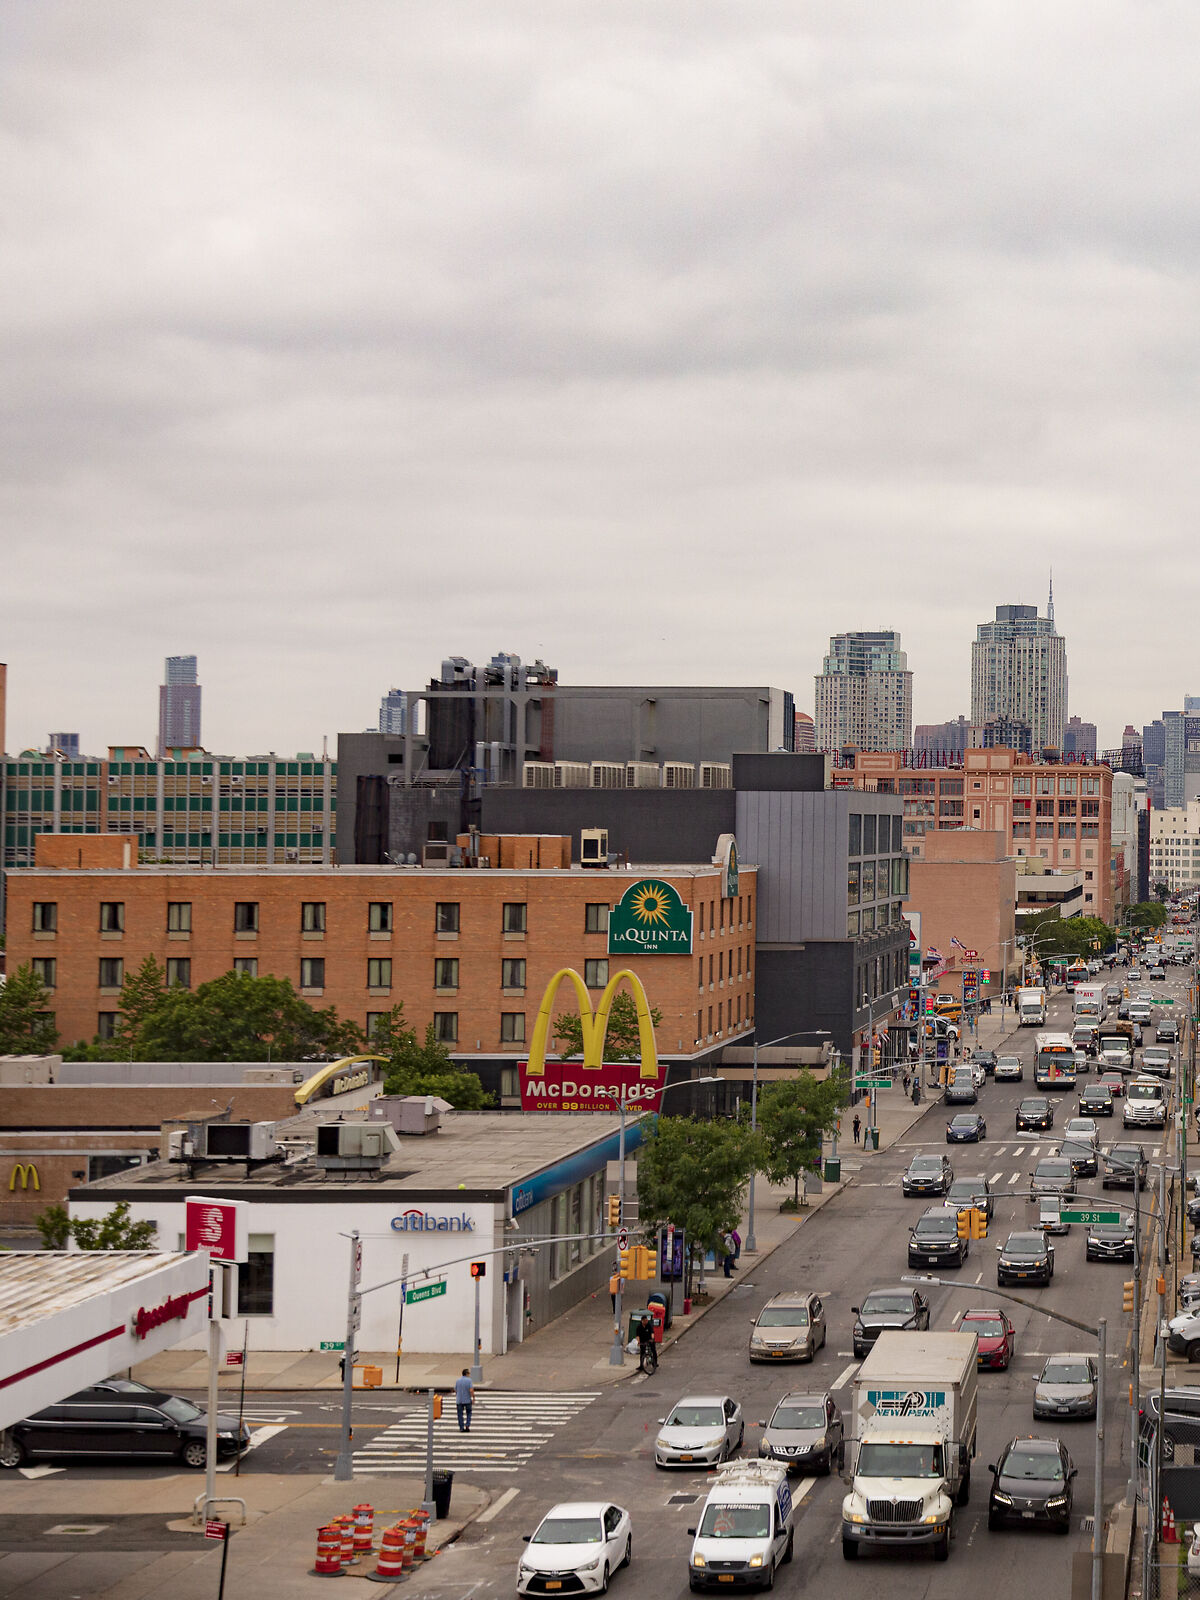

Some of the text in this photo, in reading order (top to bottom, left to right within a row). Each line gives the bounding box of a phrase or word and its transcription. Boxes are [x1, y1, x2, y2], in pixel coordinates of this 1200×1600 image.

[526, 1081, 656, 1100] McDonald's
[562, 1102, 579, 1110] 99
[516, 1191, 533, 1211] citibank
[391, 1211, 473, 1232] citibank
[1081, 1213, 1100, 1222] 39 St
[413, 1285, 442, 1301] Queens Blvd
[323, 1342, 334, 1350] 39
